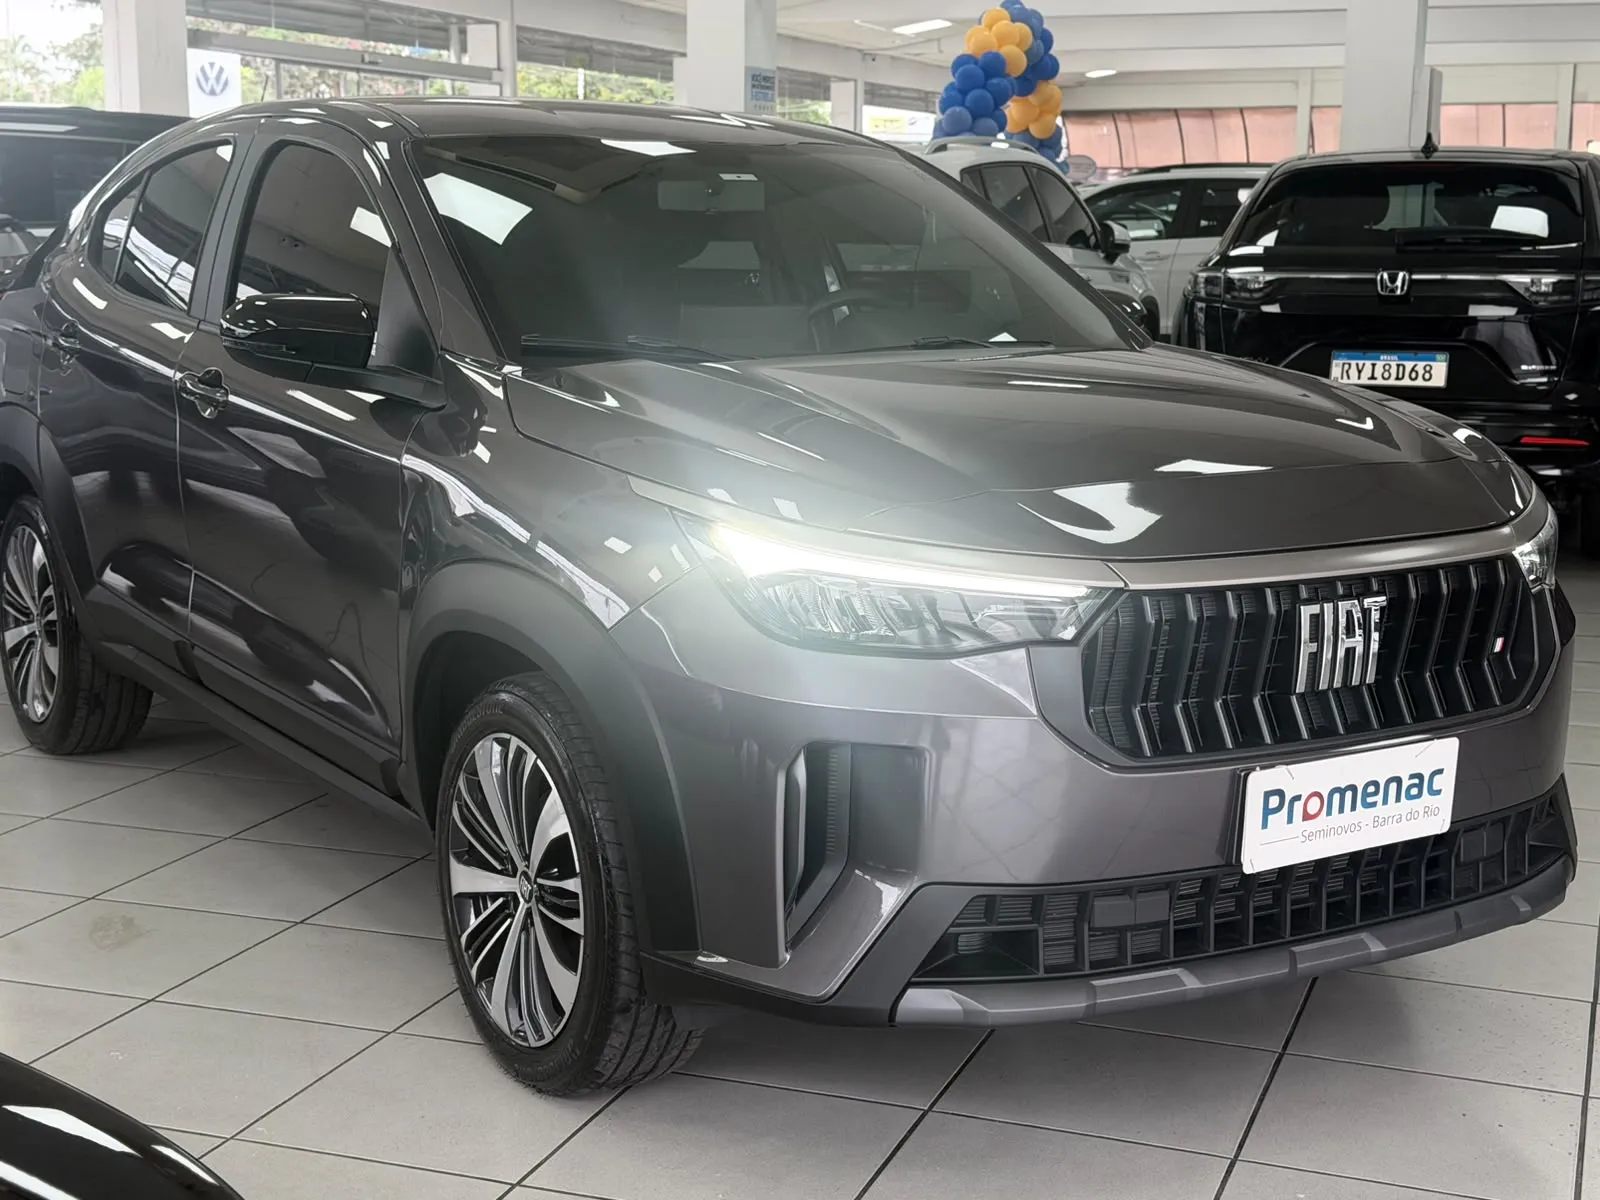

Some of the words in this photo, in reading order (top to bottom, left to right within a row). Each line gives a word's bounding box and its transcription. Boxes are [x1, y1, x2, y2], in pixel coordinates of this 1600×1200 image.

[1340, 362, 1433, 382] RYI8D68
[1296, 596, 1387, 693] FIAT
[1261, 768, 1445, 830] Promenac
[1301, 819, 1362, 843] Seminovos
[1372, 812, 1403, 829] Barra
[1405, 808, 1419, 822] do
[1422, 804, 1440, 819] Rio
